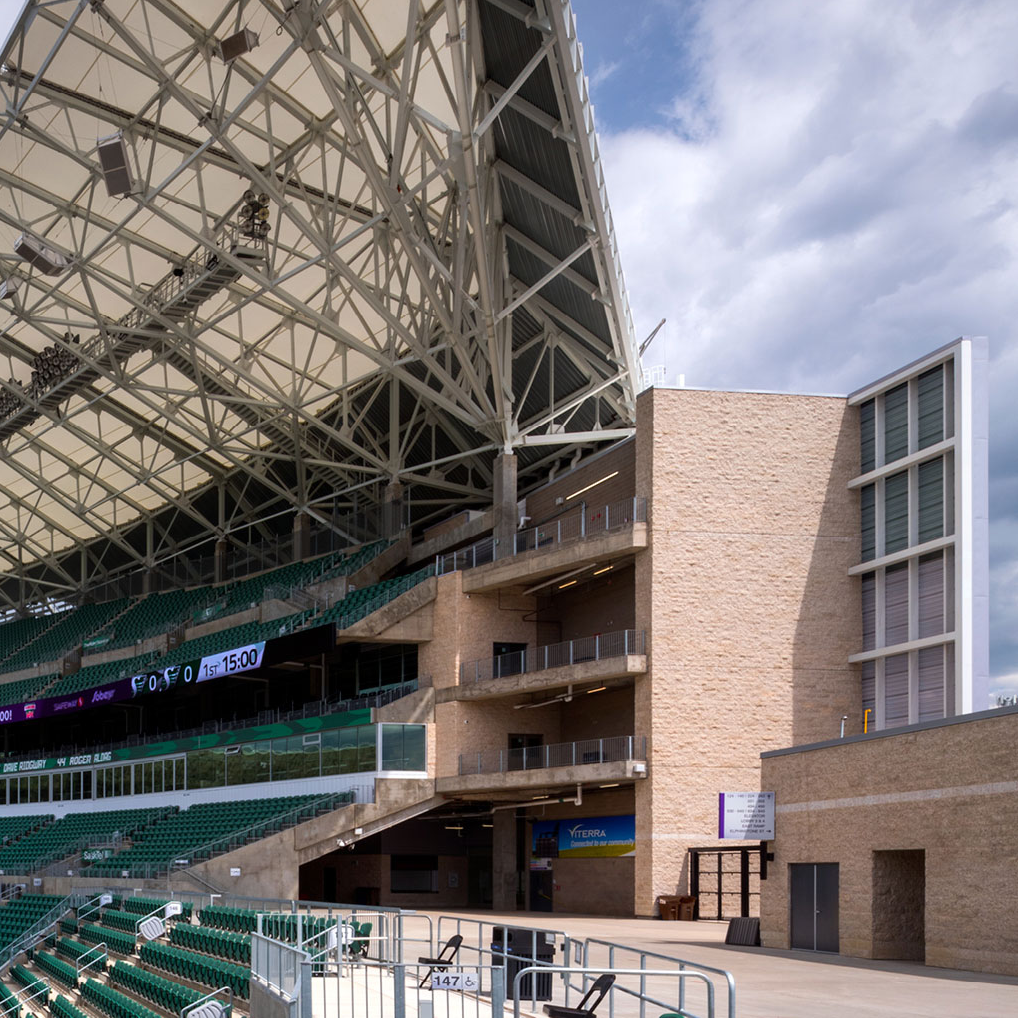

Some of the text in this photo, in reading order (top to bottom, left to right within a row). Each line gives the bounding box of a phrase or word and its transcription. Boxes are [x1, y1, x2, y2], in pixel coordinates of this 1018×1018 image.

[203, 648, 257, 680] 1ST 15:00
[148, 665, 192, 691] 0 0
[57, 752, 112, 766] 44 ROGER ALDAG
[3, 762, 18, 773] DAVE
[568, 824, 606, 838] VITERRA
[571, 840, 594, 848] Connected
[434, 976, 460, 986] 147
